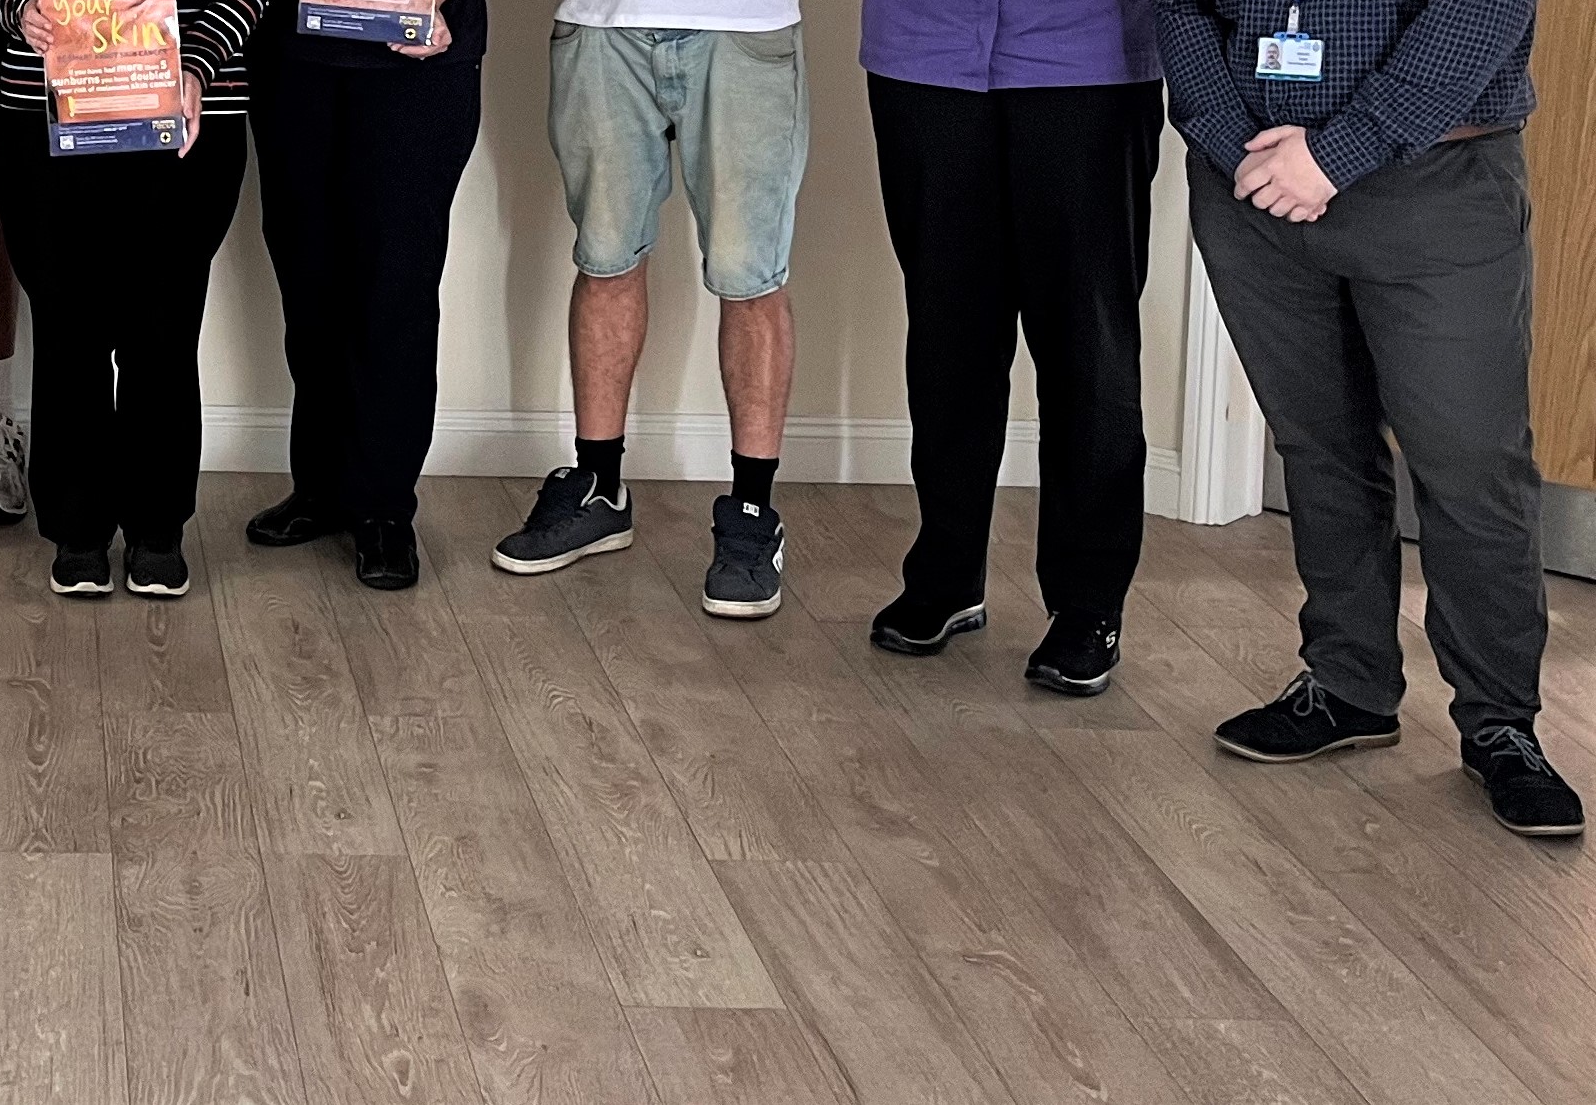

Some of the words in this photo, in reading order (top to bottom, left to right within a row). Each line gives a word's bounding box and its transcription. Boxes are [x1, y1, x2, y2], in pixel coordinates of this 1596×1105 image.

[117, 63, 143, 72] more
[51, 76, 100, 87] sunburns
[131, 70, 171, 82] doubled
